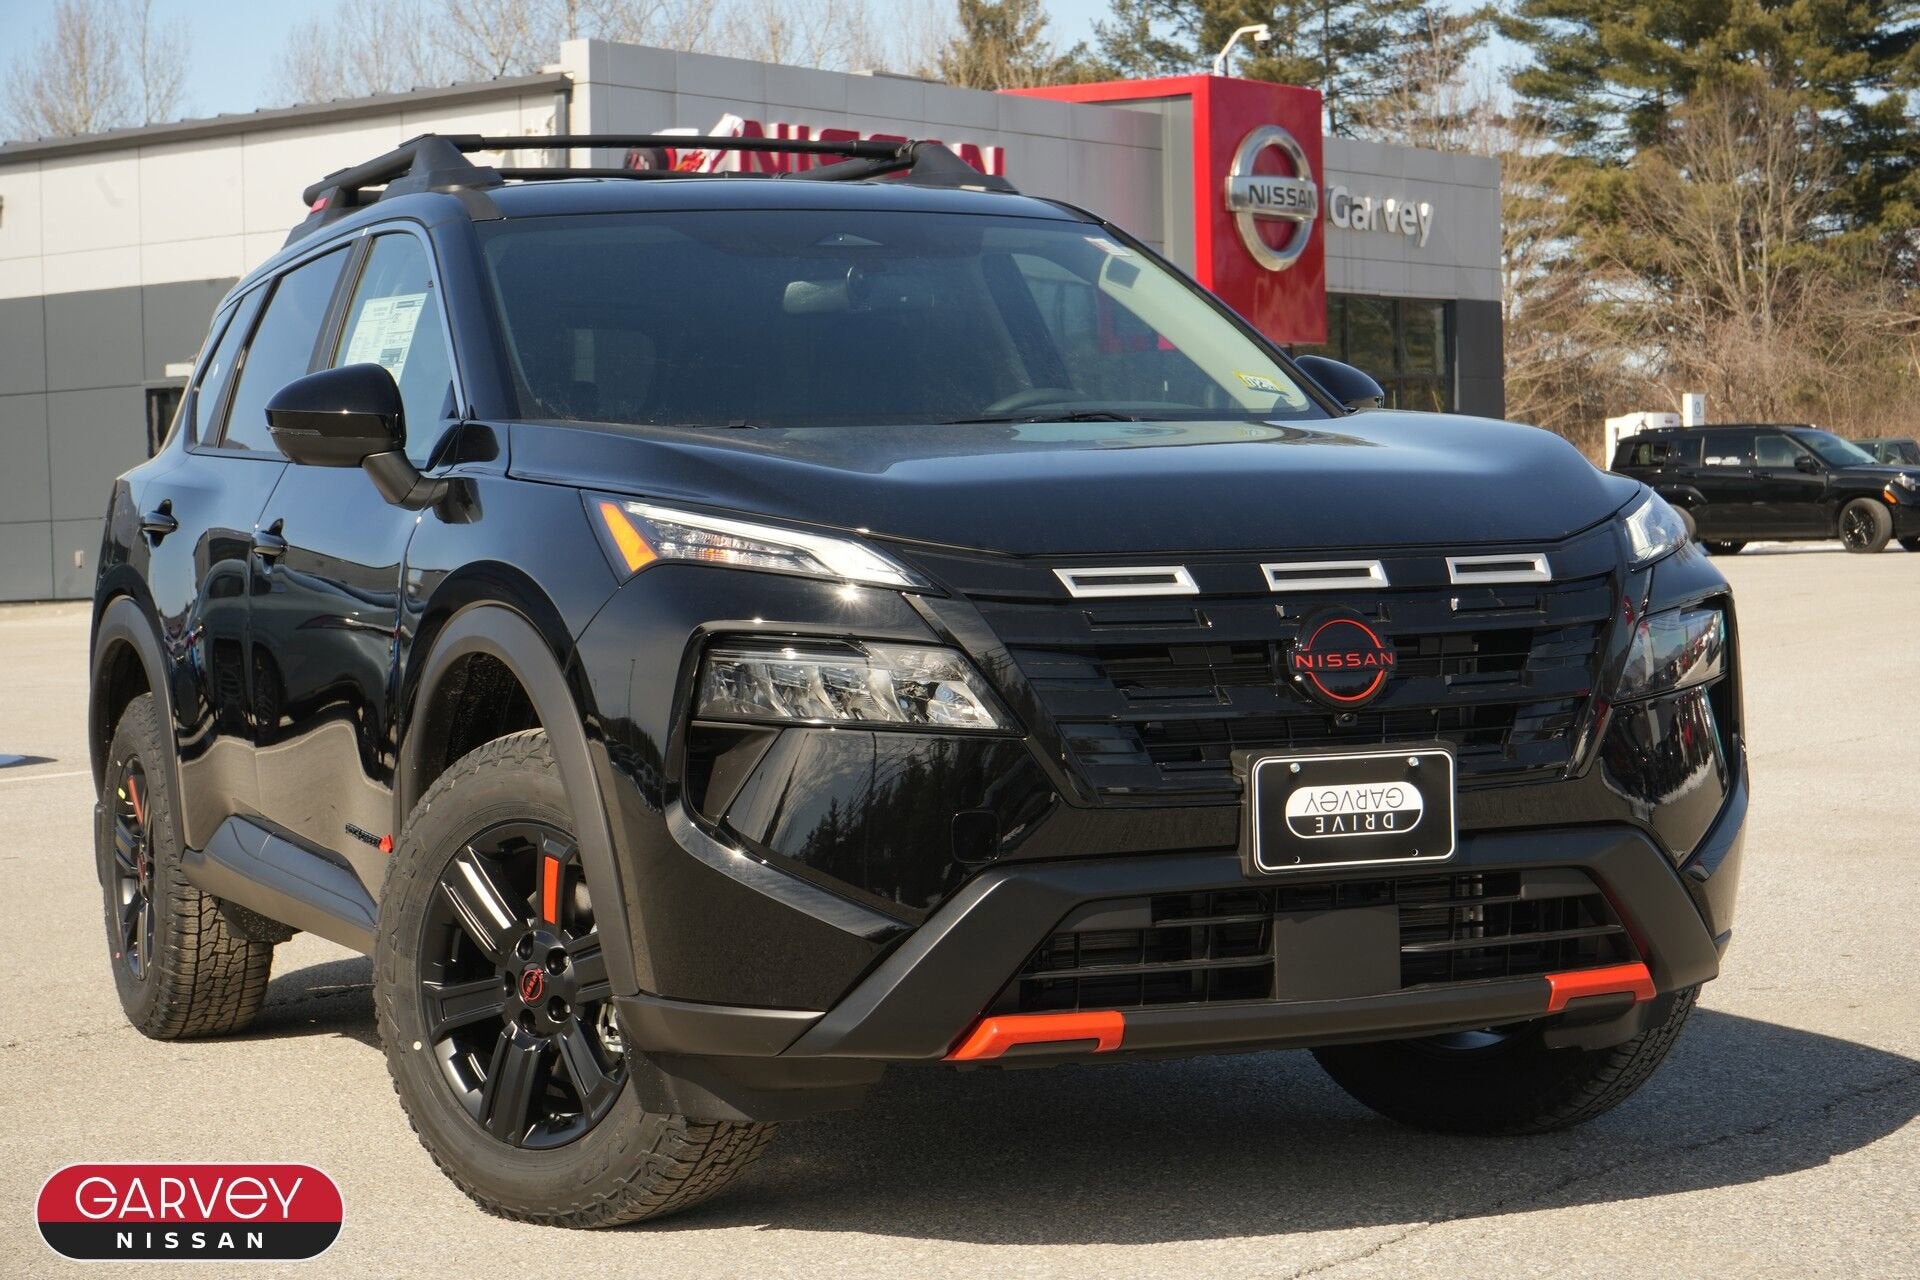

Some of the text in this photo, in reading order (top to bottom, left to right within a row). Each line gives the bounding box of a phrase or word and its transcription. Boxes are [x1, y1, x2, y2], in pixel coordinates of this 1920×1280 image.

[741, 119, 1005, 178] NIN
[1249, 184, 1316, 210] NISSAN
[1328, 184, 1434, 248] Garvey
[1294, 652, 1394, 668] NISSAN
[1315, 812, 1394, 833] DRIVE
